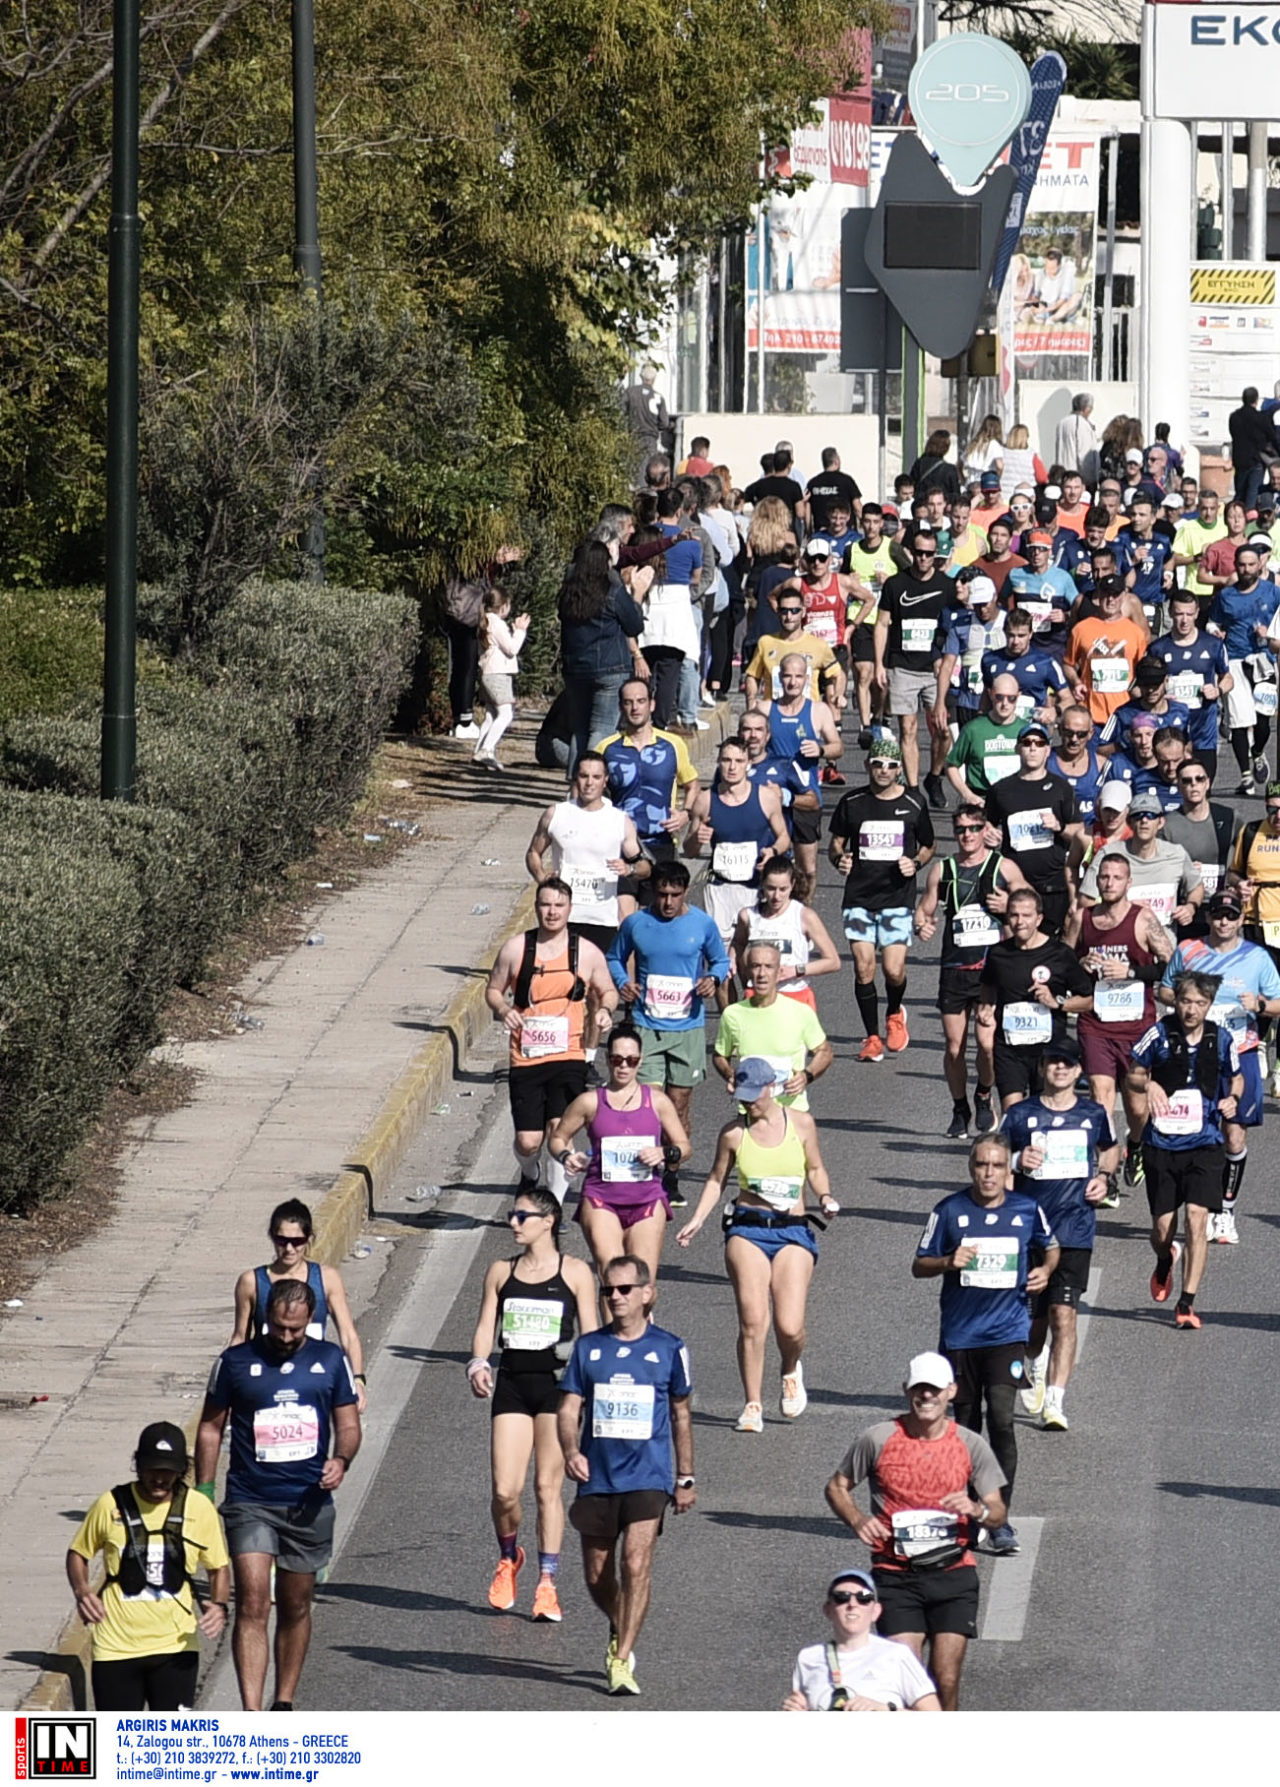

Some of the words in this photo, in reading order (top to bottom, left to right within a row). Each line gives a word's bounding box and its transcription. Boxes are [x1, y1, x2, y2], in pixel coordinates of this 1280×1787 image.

[926, 83, 1009, 102] 205
[657, 989, 681, 1002] 5663
[531, 1030, 557, 1043] 5656
[606, 1401, 638, 1417] 9136
[271, 1425, 303, 1441] 5024
